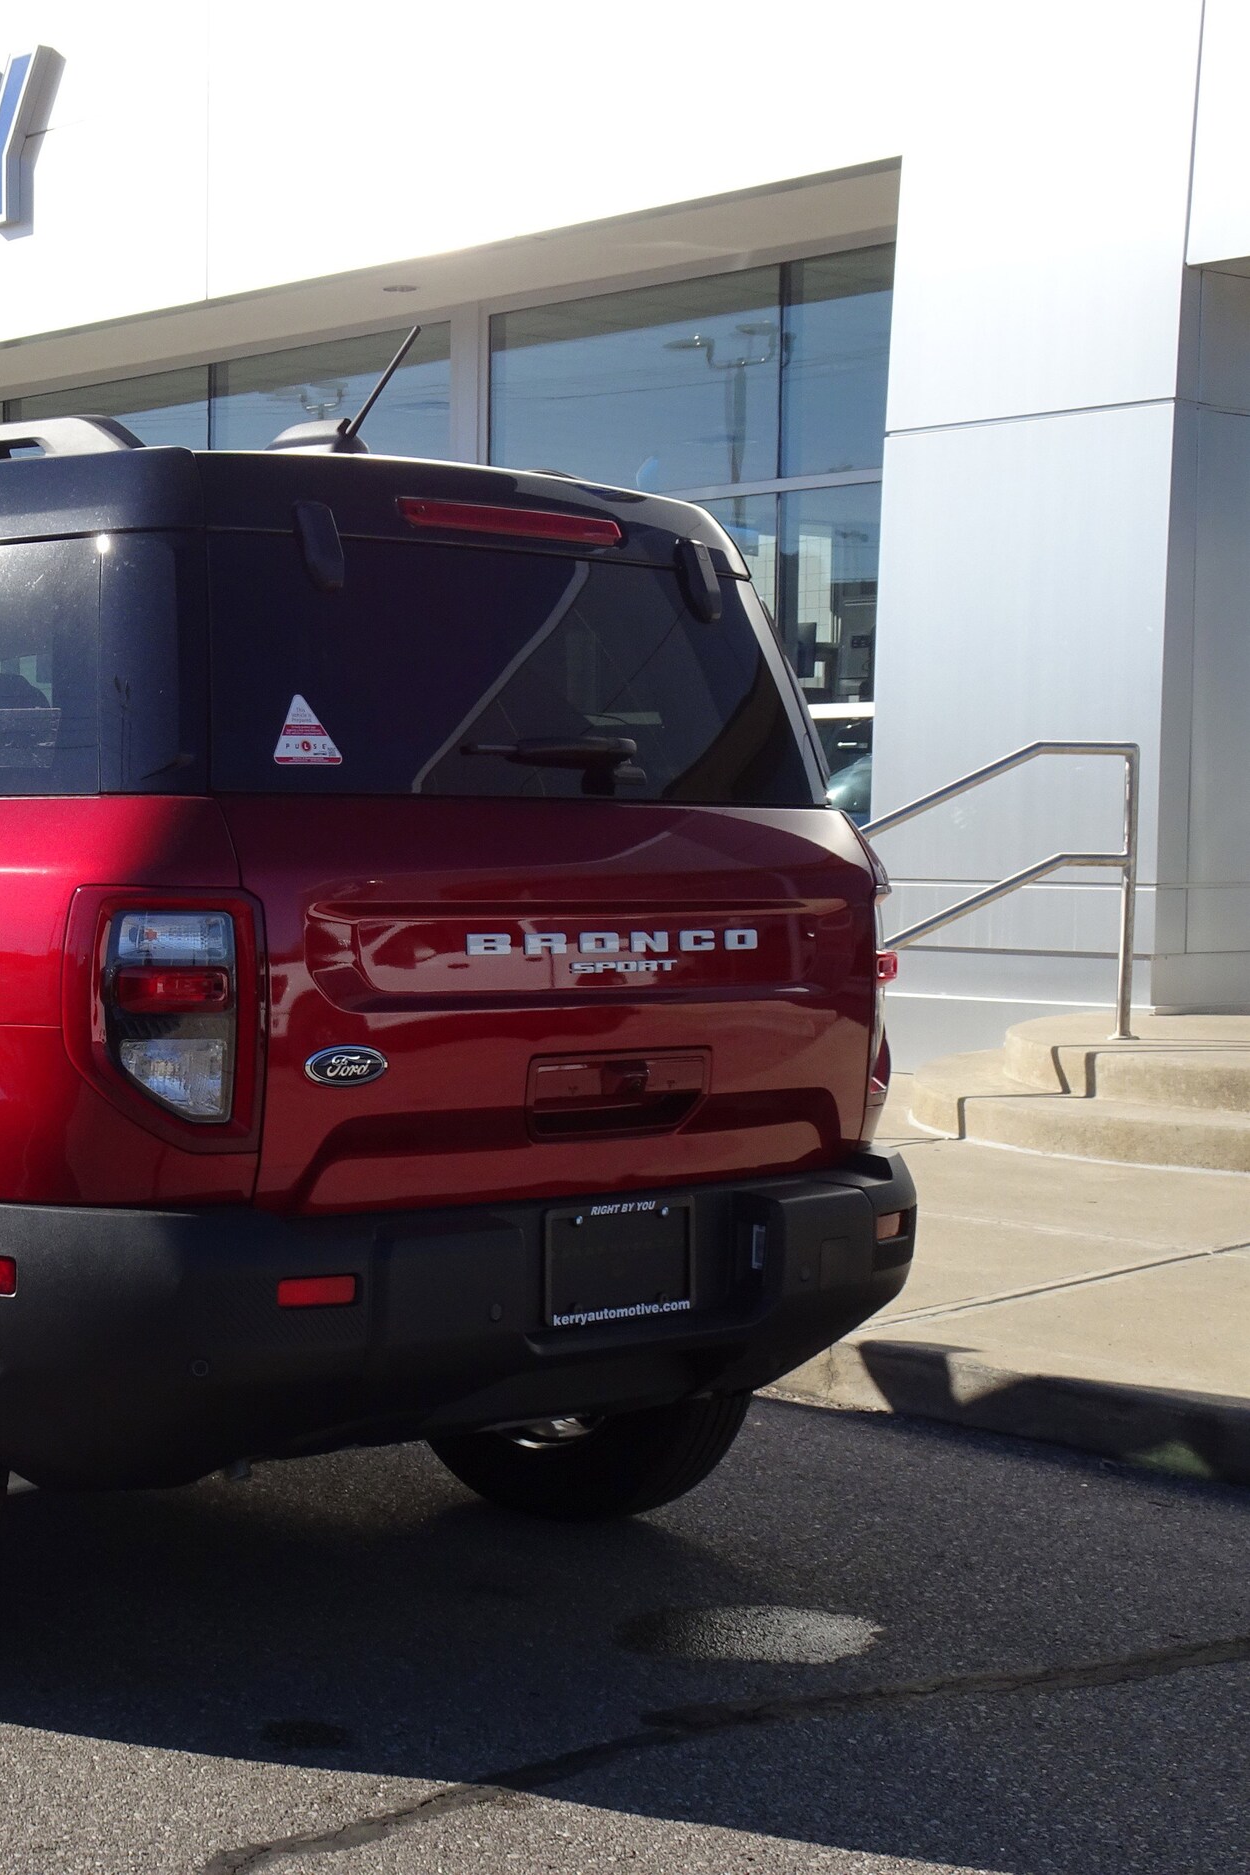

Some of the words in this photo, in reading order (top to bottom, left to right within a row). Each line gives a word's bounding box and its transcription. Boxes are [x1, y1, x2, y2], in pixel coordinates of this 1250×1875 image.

[466, 928, 759, 956] BRONCO
[569, 959, 678, 974] SPORT
[326, 1054, 371, 1077] Ford
[590, 1204, 620, 1216] RIGHT
[621, 1202, 635, 1213] BY
[636, 1200, 656, 1211] YOU
[553, 1300, 691, 1327] kerryautomotive.com
